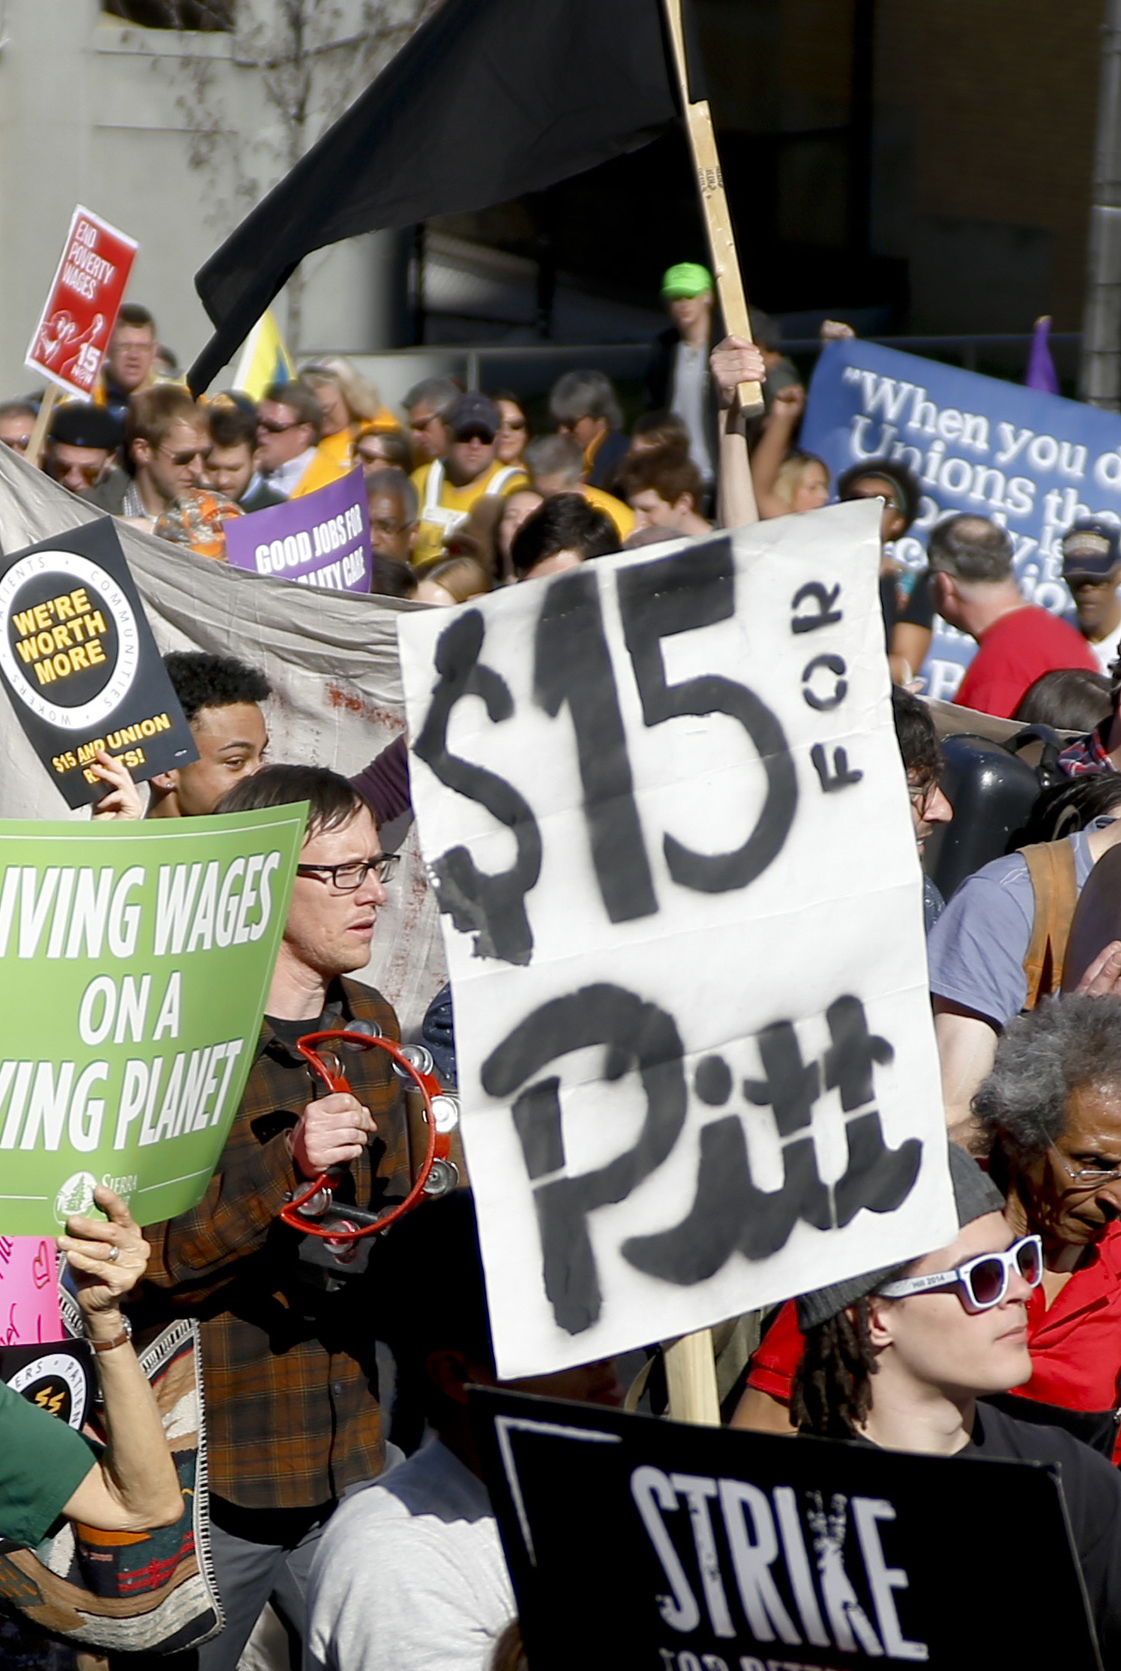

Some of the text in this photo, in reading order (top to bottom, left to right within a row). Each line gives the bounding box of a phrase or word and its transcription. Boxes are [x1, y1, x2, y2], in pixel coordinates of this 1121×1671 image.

[68, 241, 115, 285] POVERTY
[75, 220, 98, 249] END
[62, 261, 97, 300] WAGES
[78, 342, 102, 374] 15
[995, 421, 1088, 478] you
[254, 531, 313, 575] GOOD
[312, 515, 347, 558] JOBS
[11, 587, 92, 637] WE'RE
[15, 610, 108, 663] WORTH
[89, 569, 135, 709] COMMUNITIES
[32, 638, 107, 685] MORE
[789, 579, 864, 796] FOR
[51, 751, 78, 774] $15
[106, 712, 172, 750] UNION
[412, 536, 799, 966] $15
[153, 850, 281, 956] WAGES
[79, 970, 181, 1047] ON A
[112, 1037, 244, 1153] PLANET
[101, 1173, 138, 1195] SIERRA
[478, 981, 923, 1336] Pitt
[66, 1359, 85, 1424] PATIEN
[630, 1464, 930, 1661] STRIKE
